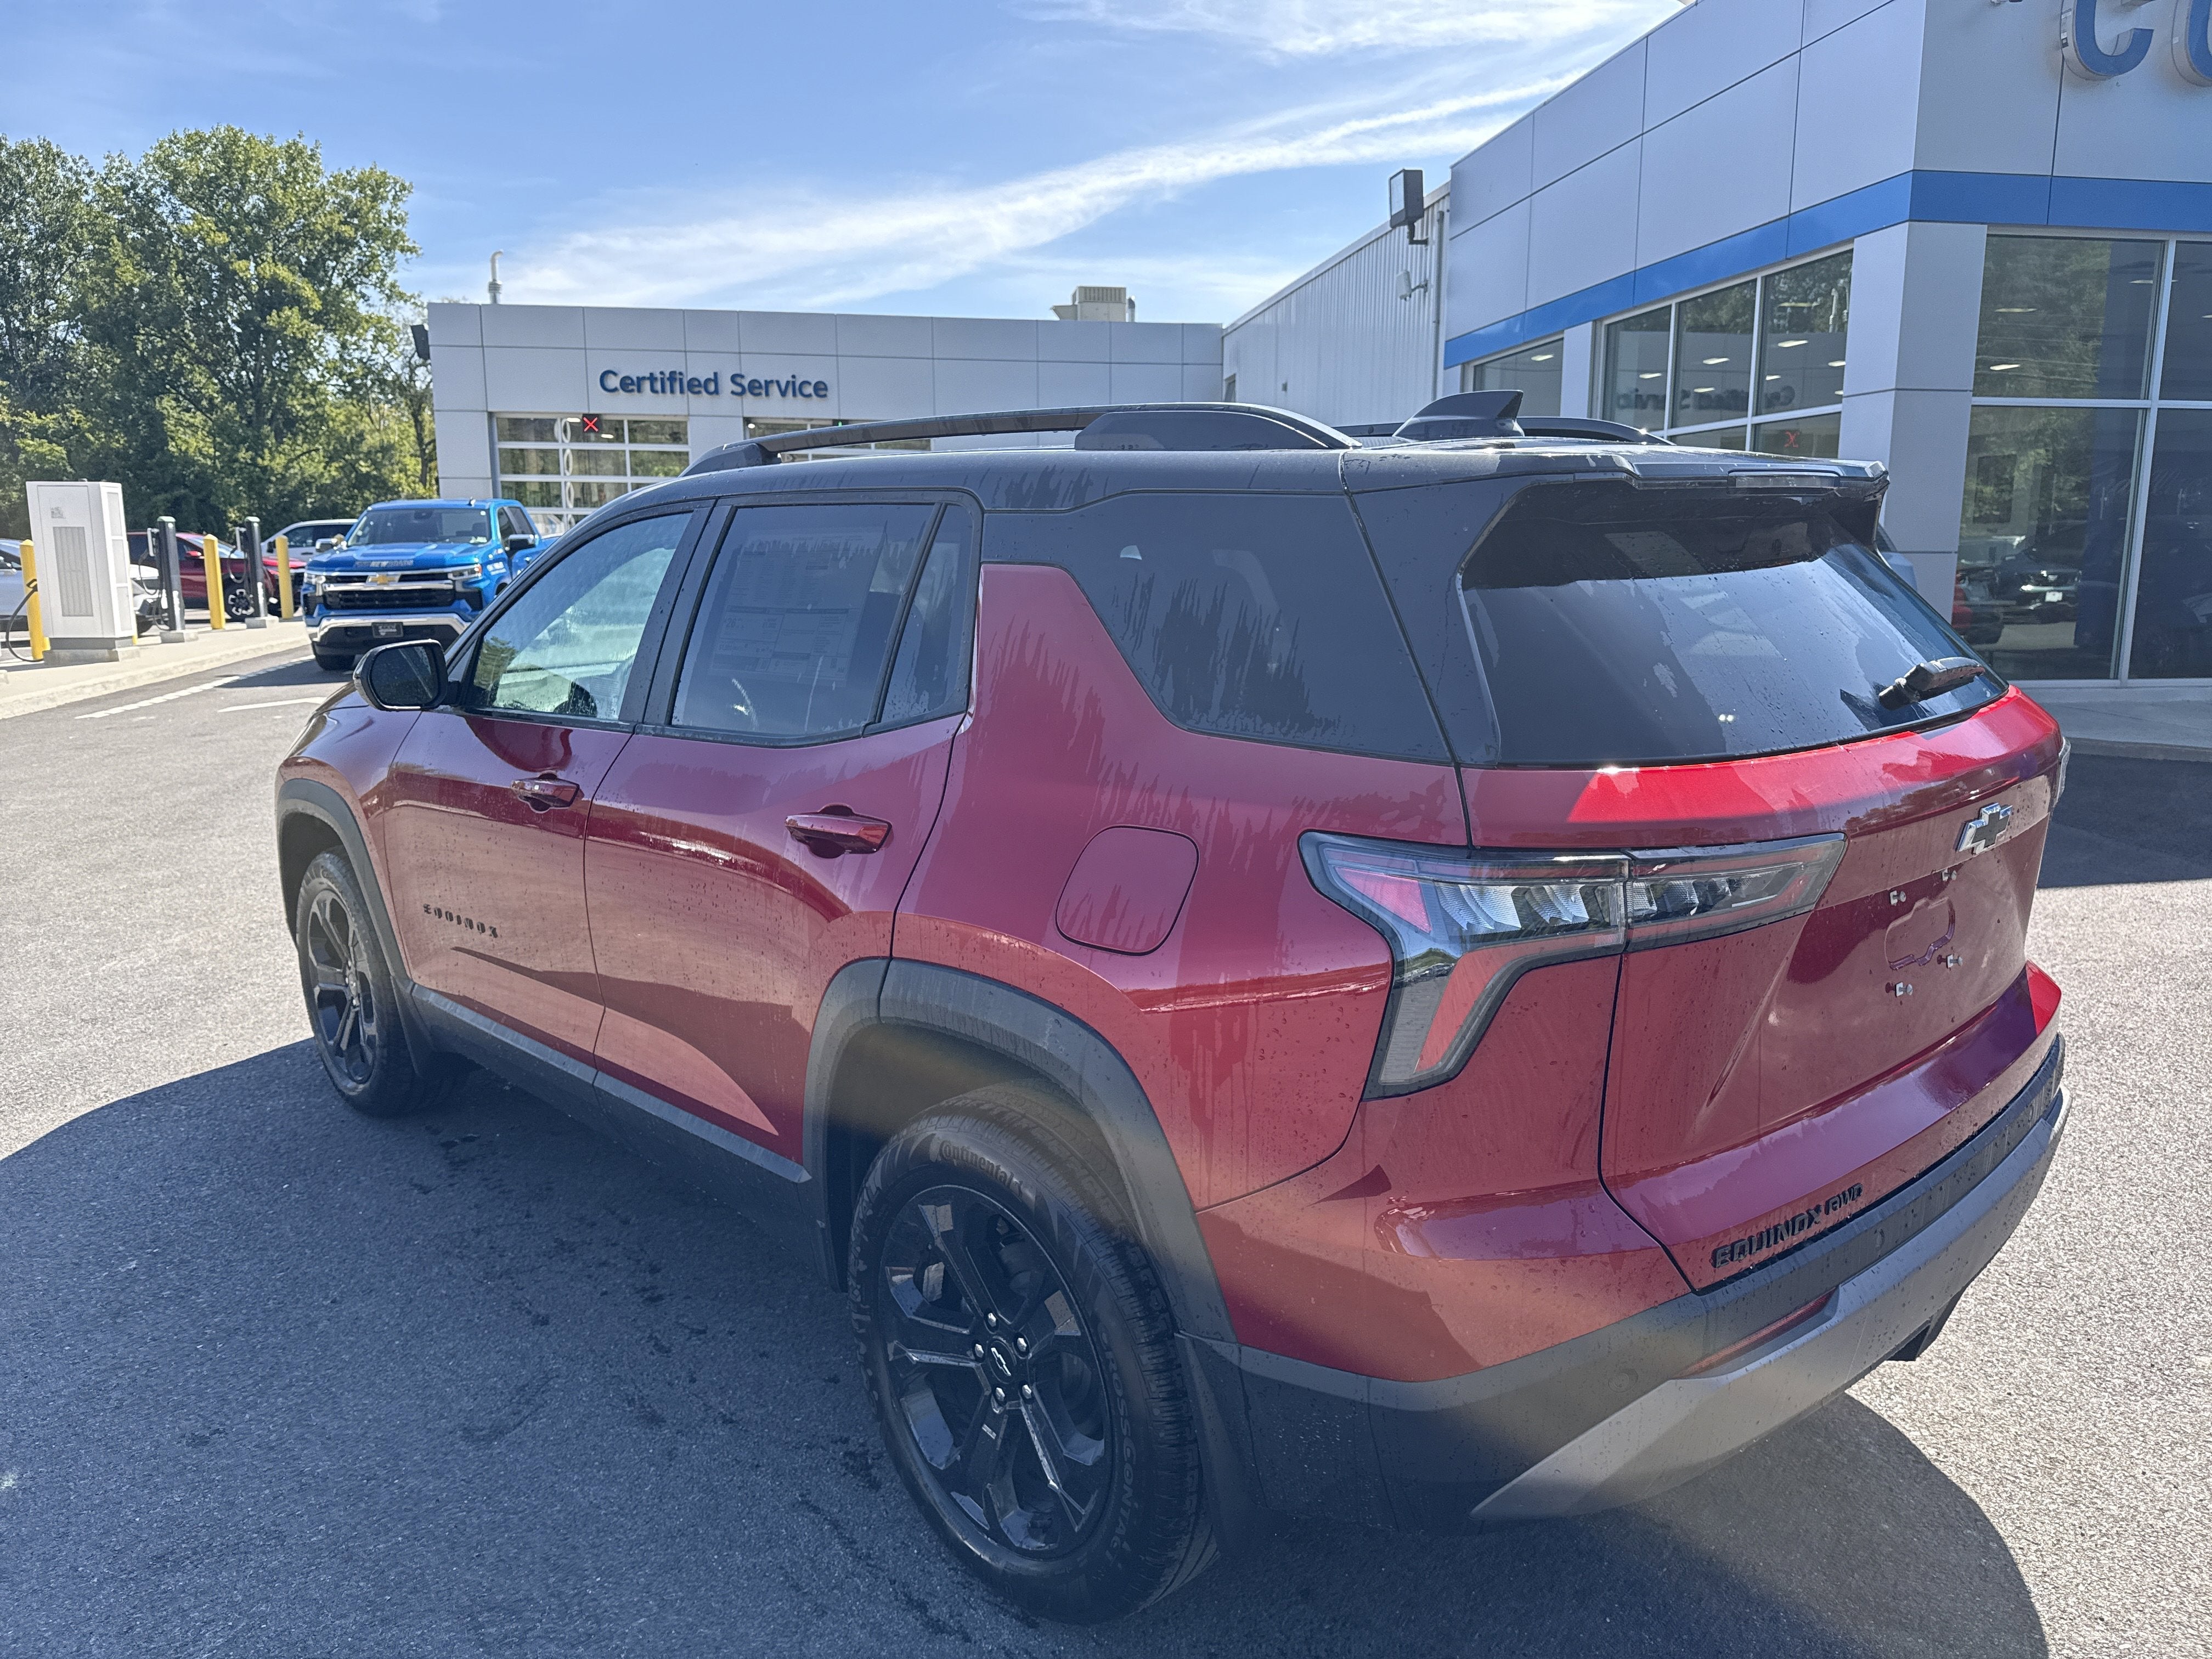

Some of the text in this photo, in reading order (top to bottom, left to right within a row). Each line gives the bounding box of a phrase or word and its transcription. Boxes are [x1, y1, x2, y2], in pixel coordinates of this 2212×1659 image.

[599, 369, 828, 398] Certified Service
[939, 1139, 1015, 1189] Continental
[1710, 1182, 1864, 1268] EQUINOX AWD
